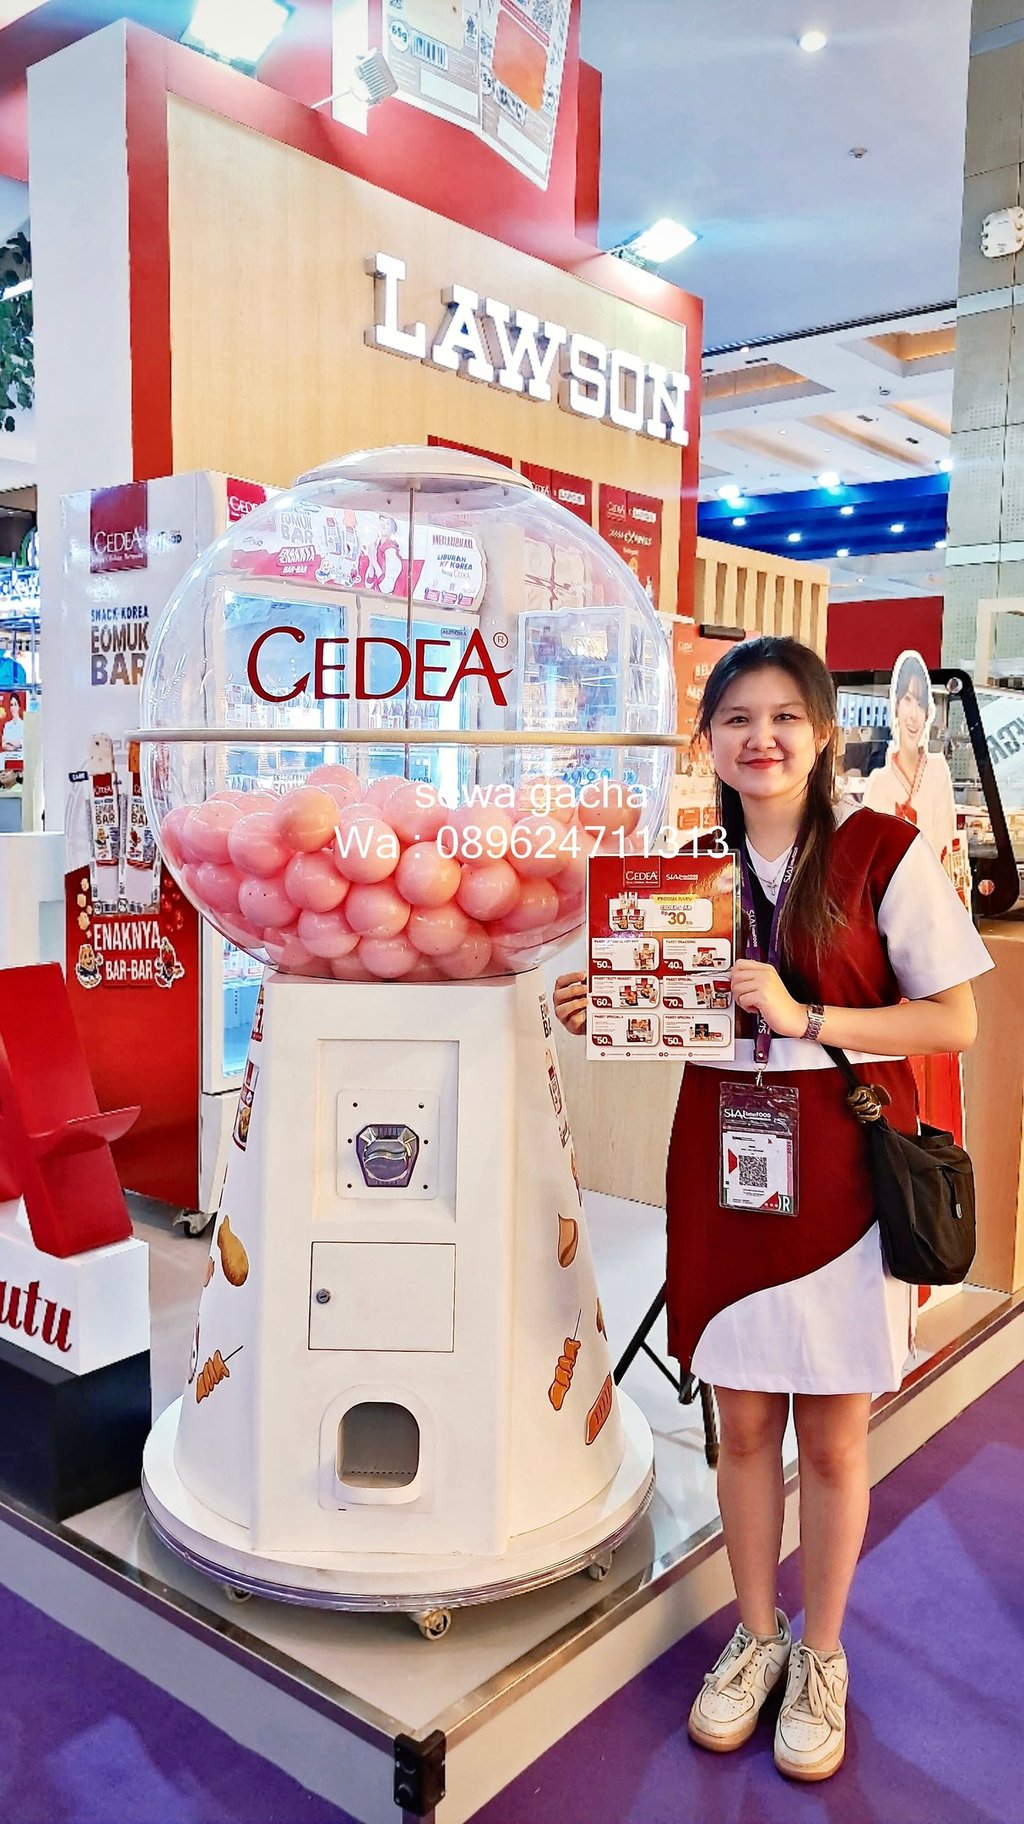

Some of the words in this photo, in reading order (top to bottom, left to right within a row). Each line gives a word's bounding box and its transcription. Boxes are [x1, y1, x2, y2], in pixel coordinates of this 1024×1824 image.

[366, 252, 691, 447] LAWSON
[281, 524, 313, 544] BAR
[437, 553, 466, 563] LIBURAN
[450, 562, 473, 571] KOREA
[91, 622, 149, 653] EOMUK
[96, 814, 115, 825] BAR
[625, 870, 658, 880] CEDEA
[668, 911, 686, 925] 30
[93, 920, 161, 951] ENAKNYA
[596, 960, 608, 969] 50
[668, 961, 679, 970] 40
[105, 958, 153, 982] BAR-BAR
[596, 998, 608, 1007] 60
[668, 999, 679, 1007] 70
[597, 1036, 608, 1045] 50
[668, 1037, 679, 1045] 50
